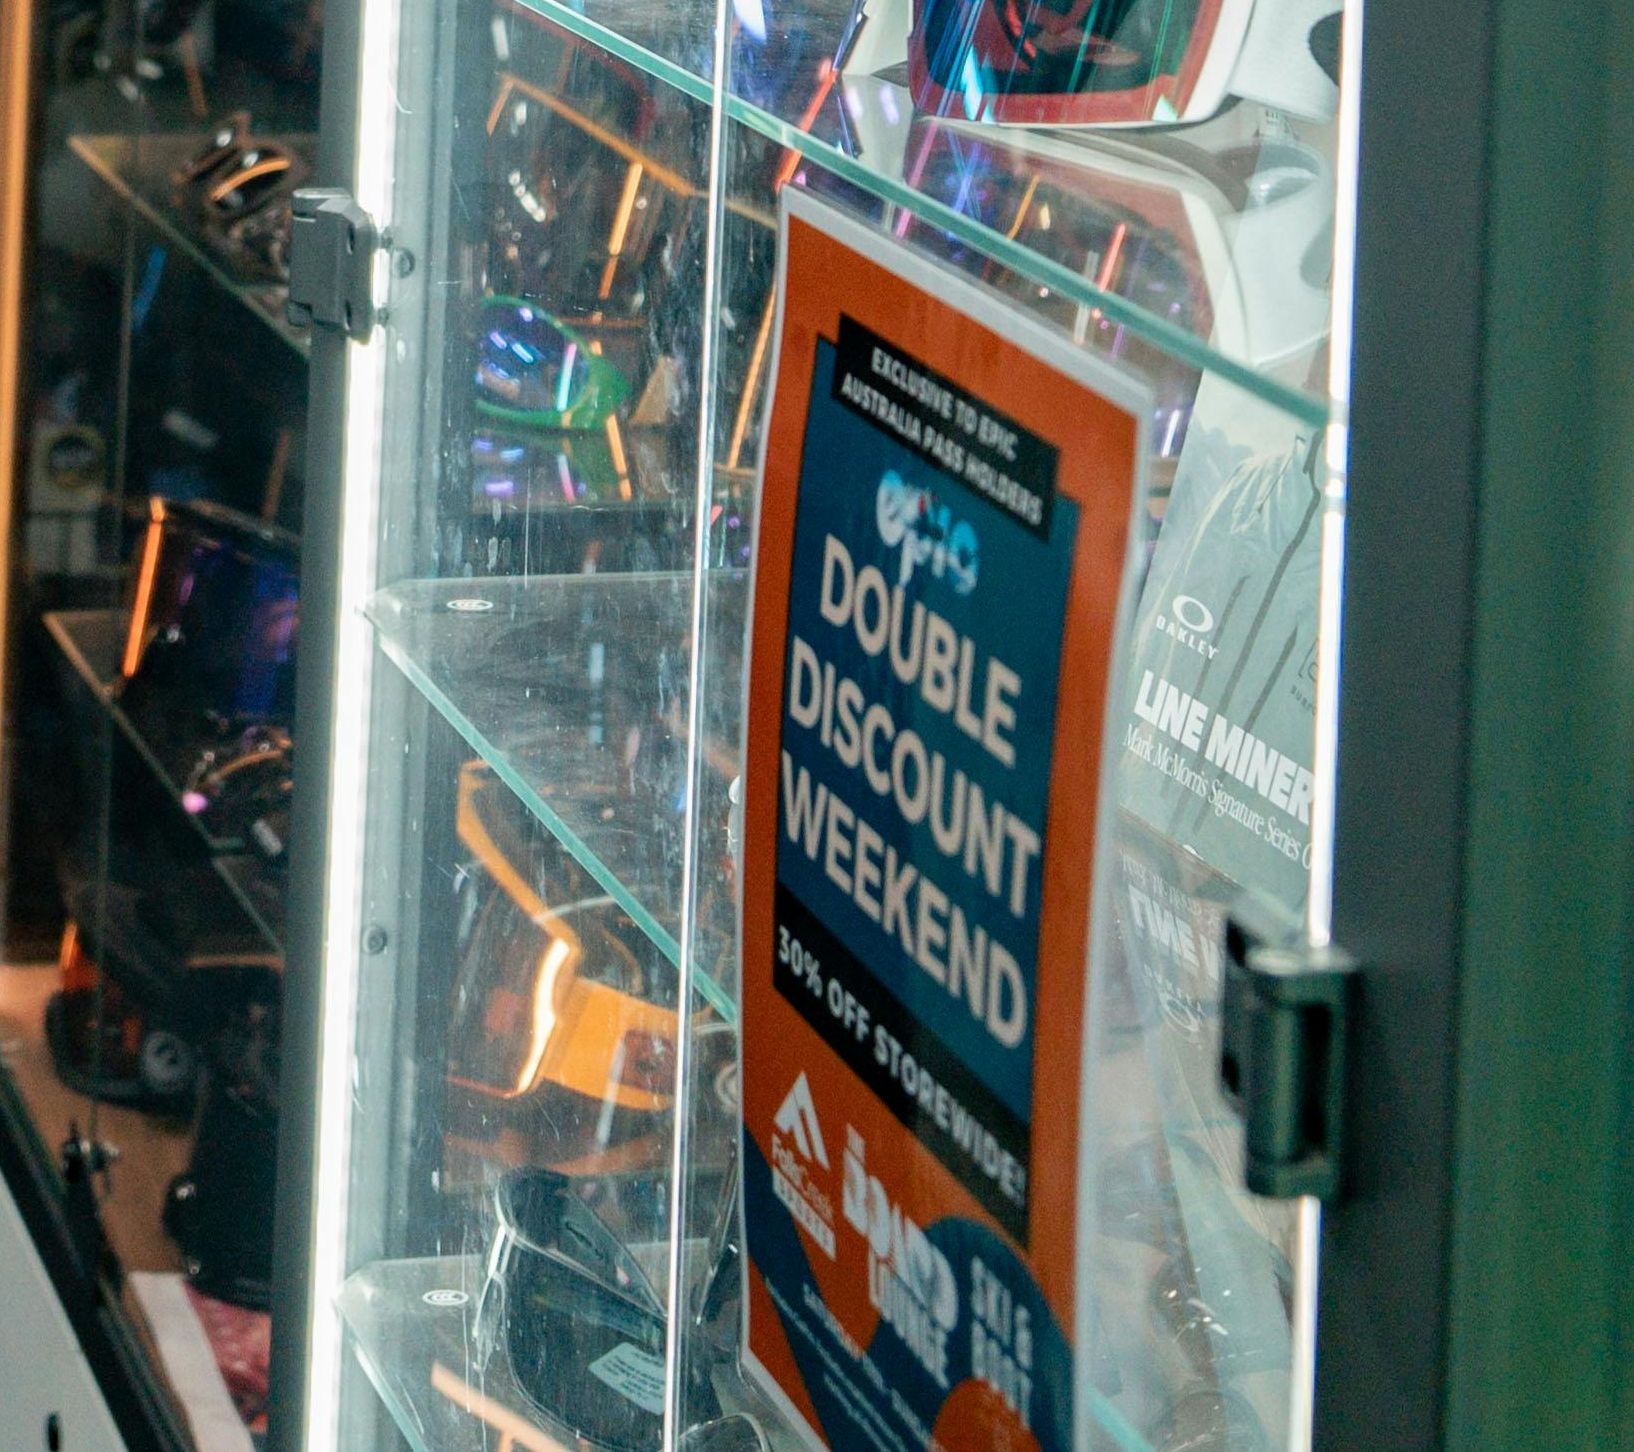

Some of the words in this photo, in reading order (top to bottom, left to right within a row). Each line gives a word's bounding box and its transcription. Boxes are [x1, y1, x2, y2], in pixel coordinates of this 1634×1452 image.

[839, 372, 923, 449] AUSTRALIA
[922, 422, 965, 478] PASS
[964, 452, 1045, 529] HOLDERS
[870, 346, 954, 422] EXCLUSIVE
[951, 396, 978, 433] TO
[978, 411, 1019, 463] EPIC
[819, 533, 1023, 768] DOUBLE
[1154, 615, 1220, 660] OAKLEY
[788, 636, 1042, 921] DISCOUNT
[1122, 722, 1156, 766] Mark
[1153, 745, 1208, 801] McMorris
[1207, 775, 1266, 838] Signature
[1263, 815, 1302, 862] Series
[1134, 670, 1205, 753] LINE
[1207, 712, 1315, 827] MINER
[779, 750, 1029, 1050] WEEKEND
[777, 924, 824, 1000] 30%
[827, 977, 871, 1042] OFF
[873, 1023, 1029, 1208] STOREWIDE!
